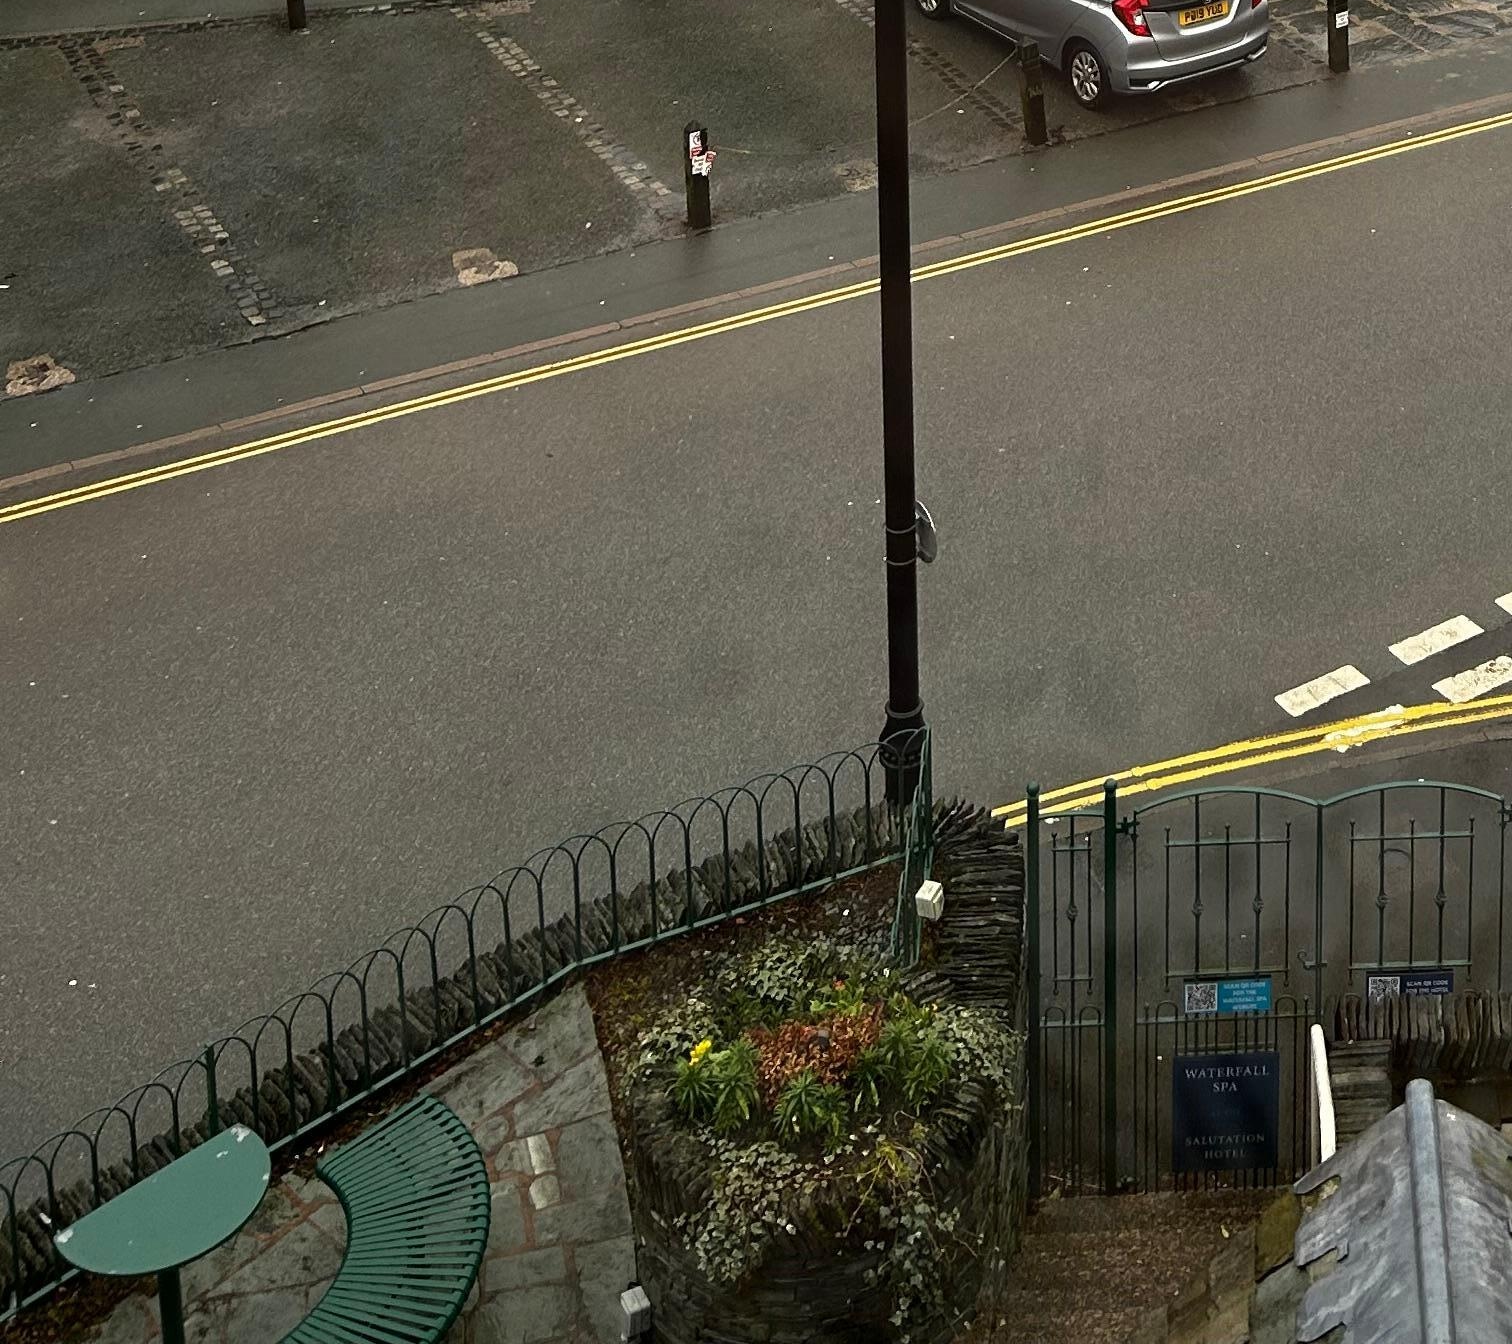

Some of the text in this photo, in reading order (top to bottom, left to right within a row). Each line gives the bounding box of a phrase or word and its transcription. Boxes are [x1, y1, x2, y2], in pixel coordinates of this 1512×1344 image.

[1185, 1065, 1269, 1079] WATERFALL
[1213, 1081, 1238, 1092] SPA
[1185, 1133, 1265, 1147] SALUTATION
[1204, 1149, 1247, 1160] HOTEL
